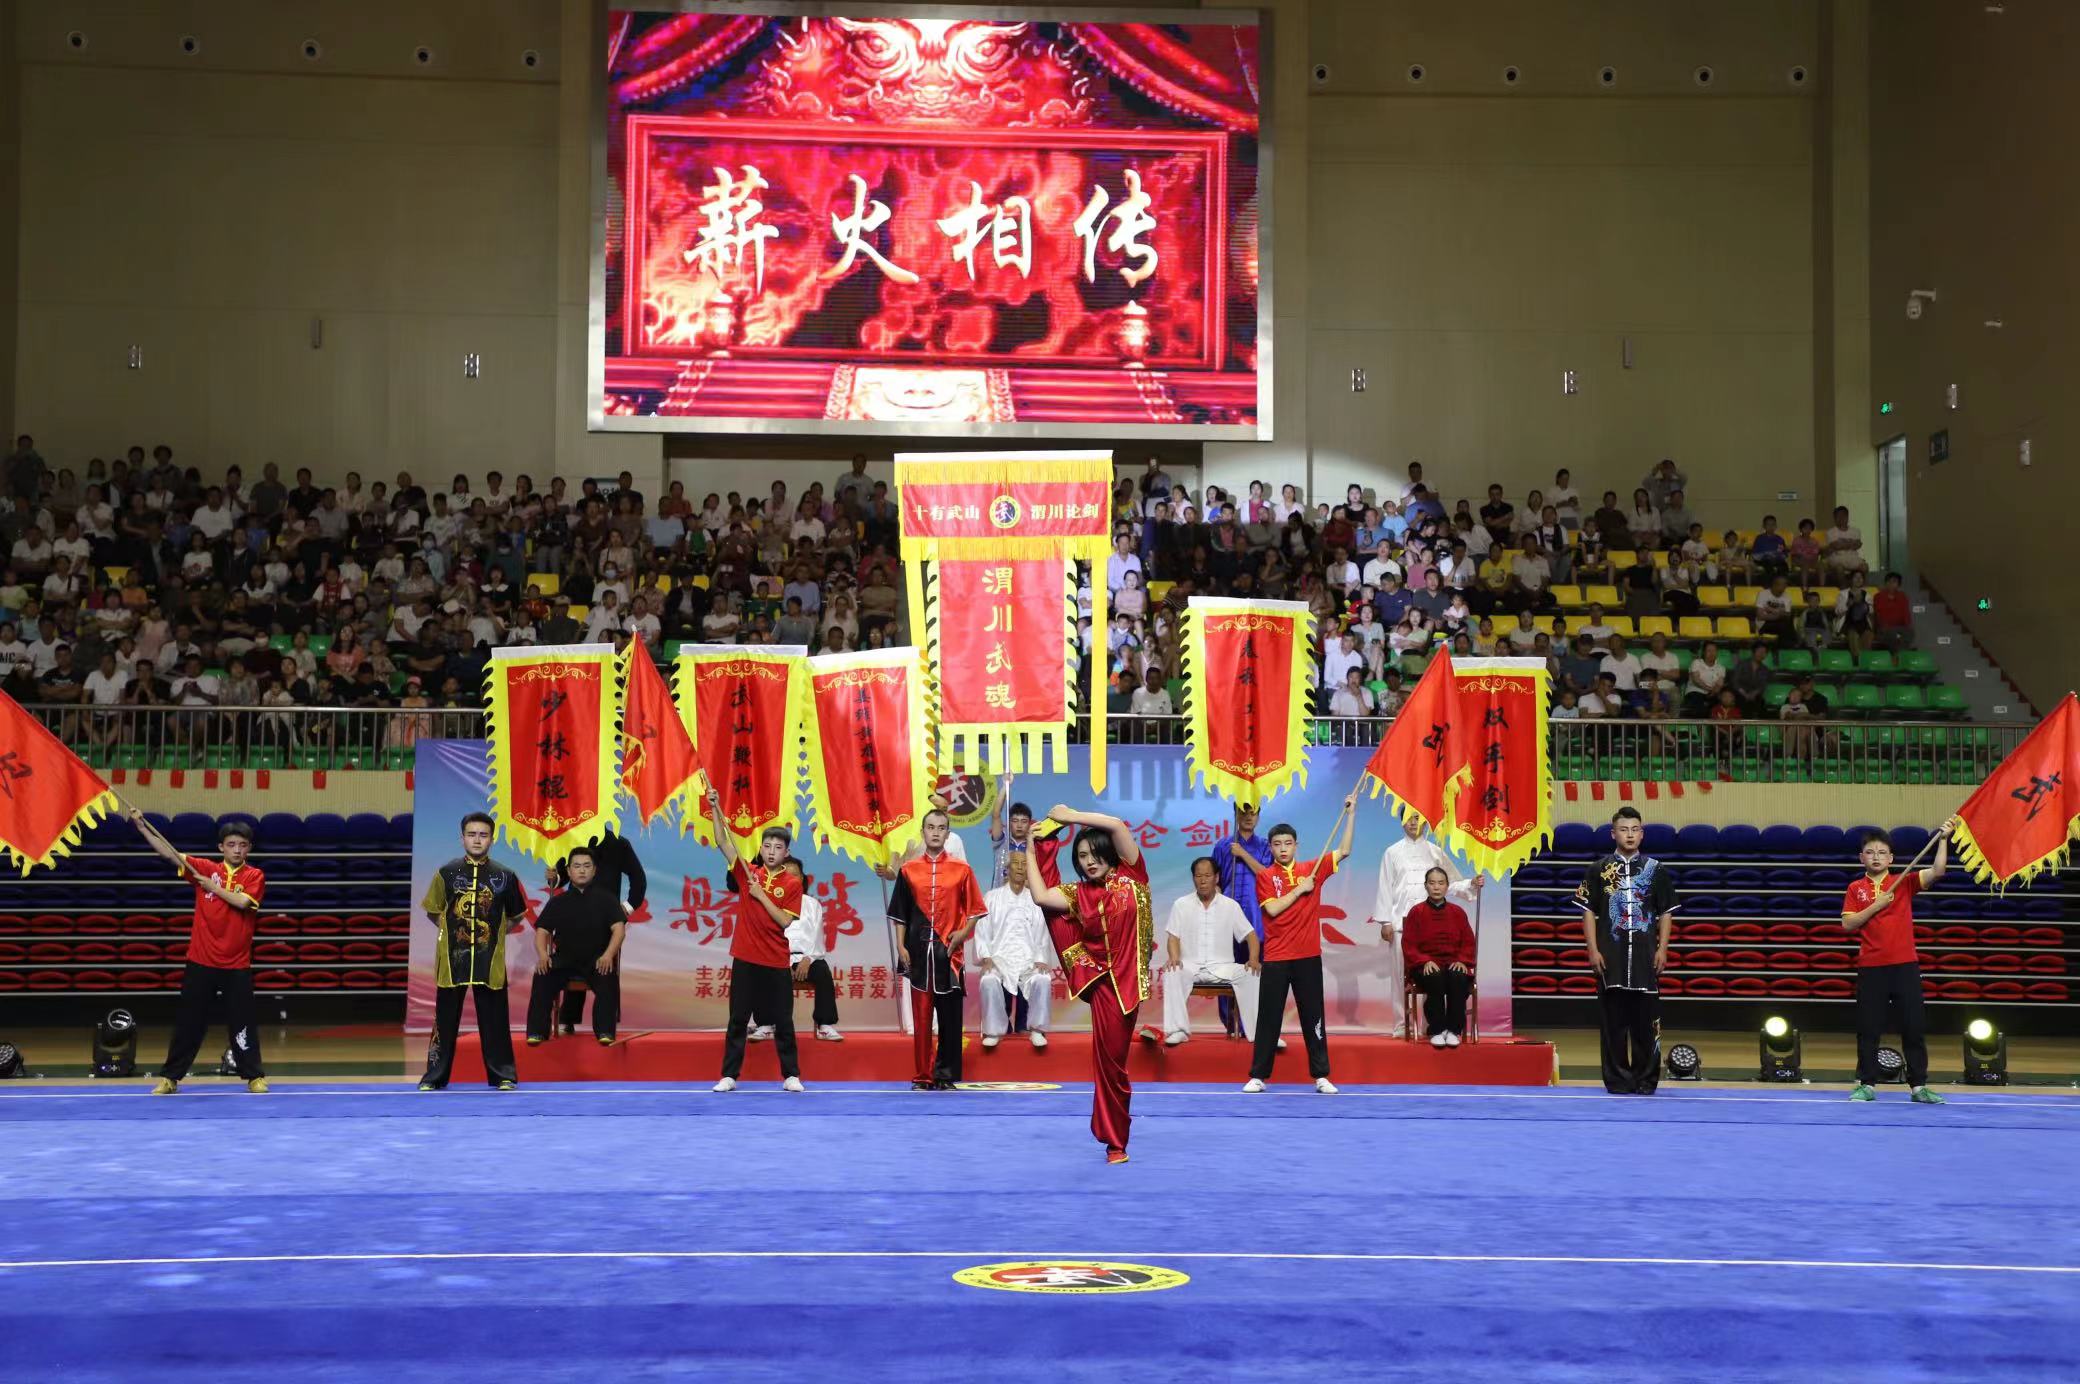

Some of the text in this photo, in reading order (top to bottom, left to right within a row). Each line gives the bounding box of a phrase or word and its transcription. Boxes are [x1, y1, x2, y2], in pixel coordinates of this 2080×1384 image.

[684, 164, 1160, 295] 薪火相传
[912, 504, 979, 521] 十有武山
[981, 566, 1017, 709] 渭川武魂
[538, 689, 569, 799] 少林棍
